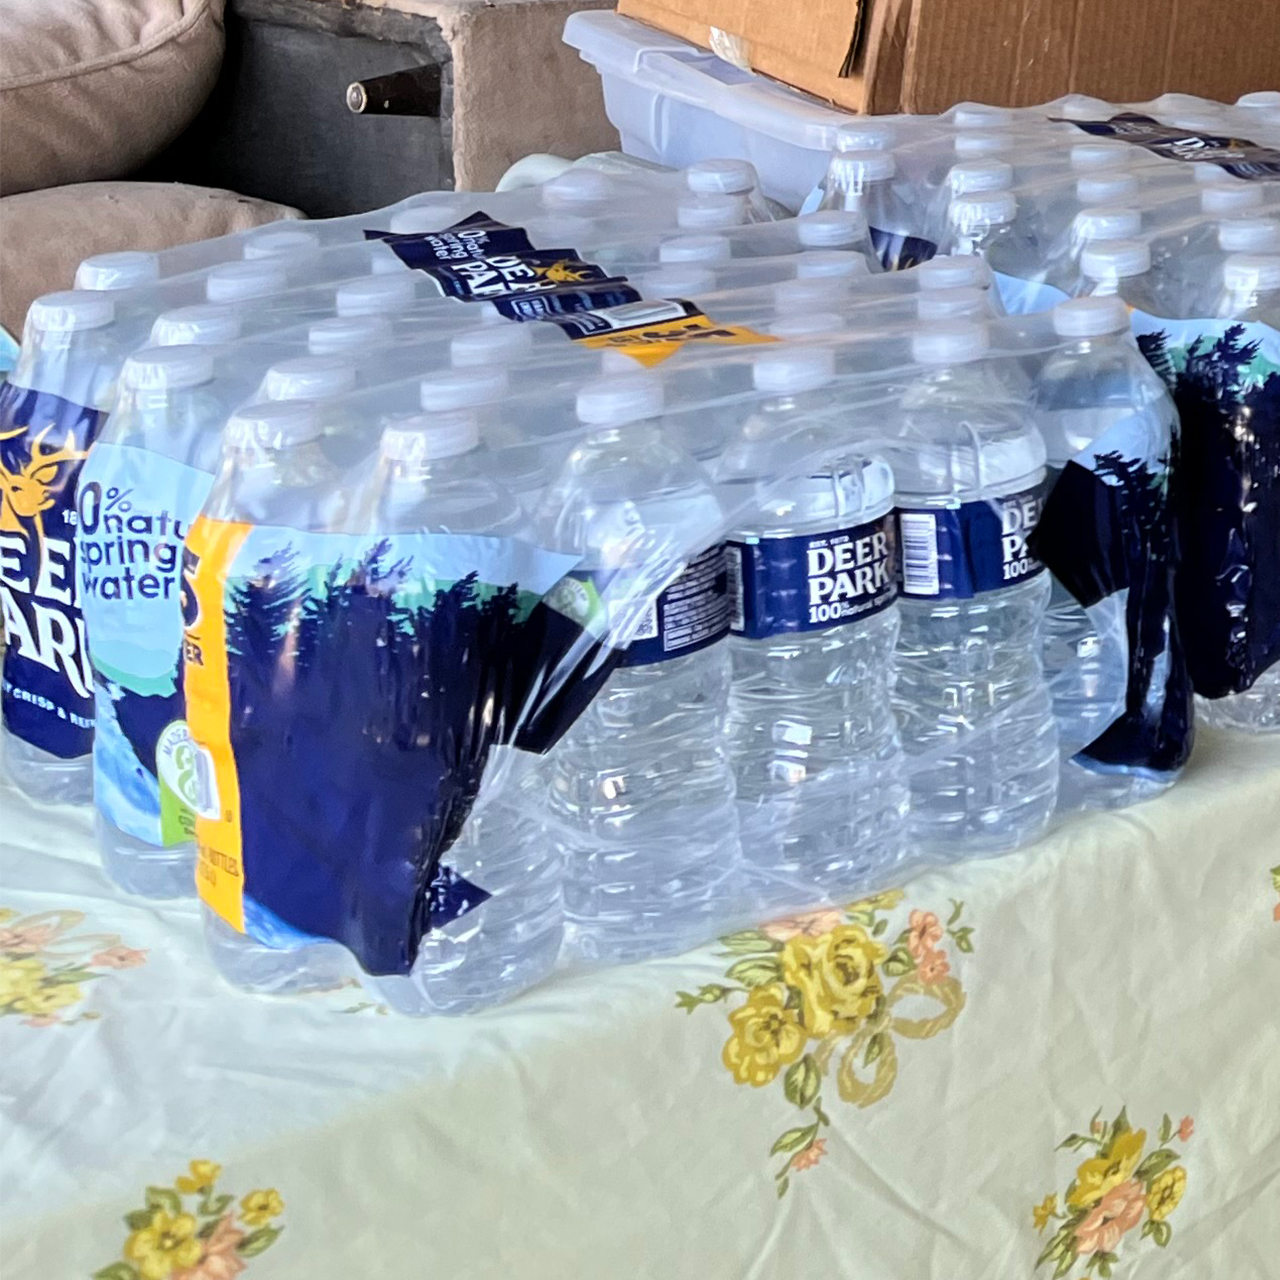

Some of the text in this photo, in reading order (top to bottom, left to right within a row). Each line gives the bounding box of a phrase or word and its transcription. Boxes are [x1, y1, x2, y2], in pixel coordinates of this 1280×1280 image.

[806, 531, 888, 577] DEER
[82, 570, 176, 601] water
[808, 557, 890, 606] PARK
[13, 687, 55, 711] CRISP
